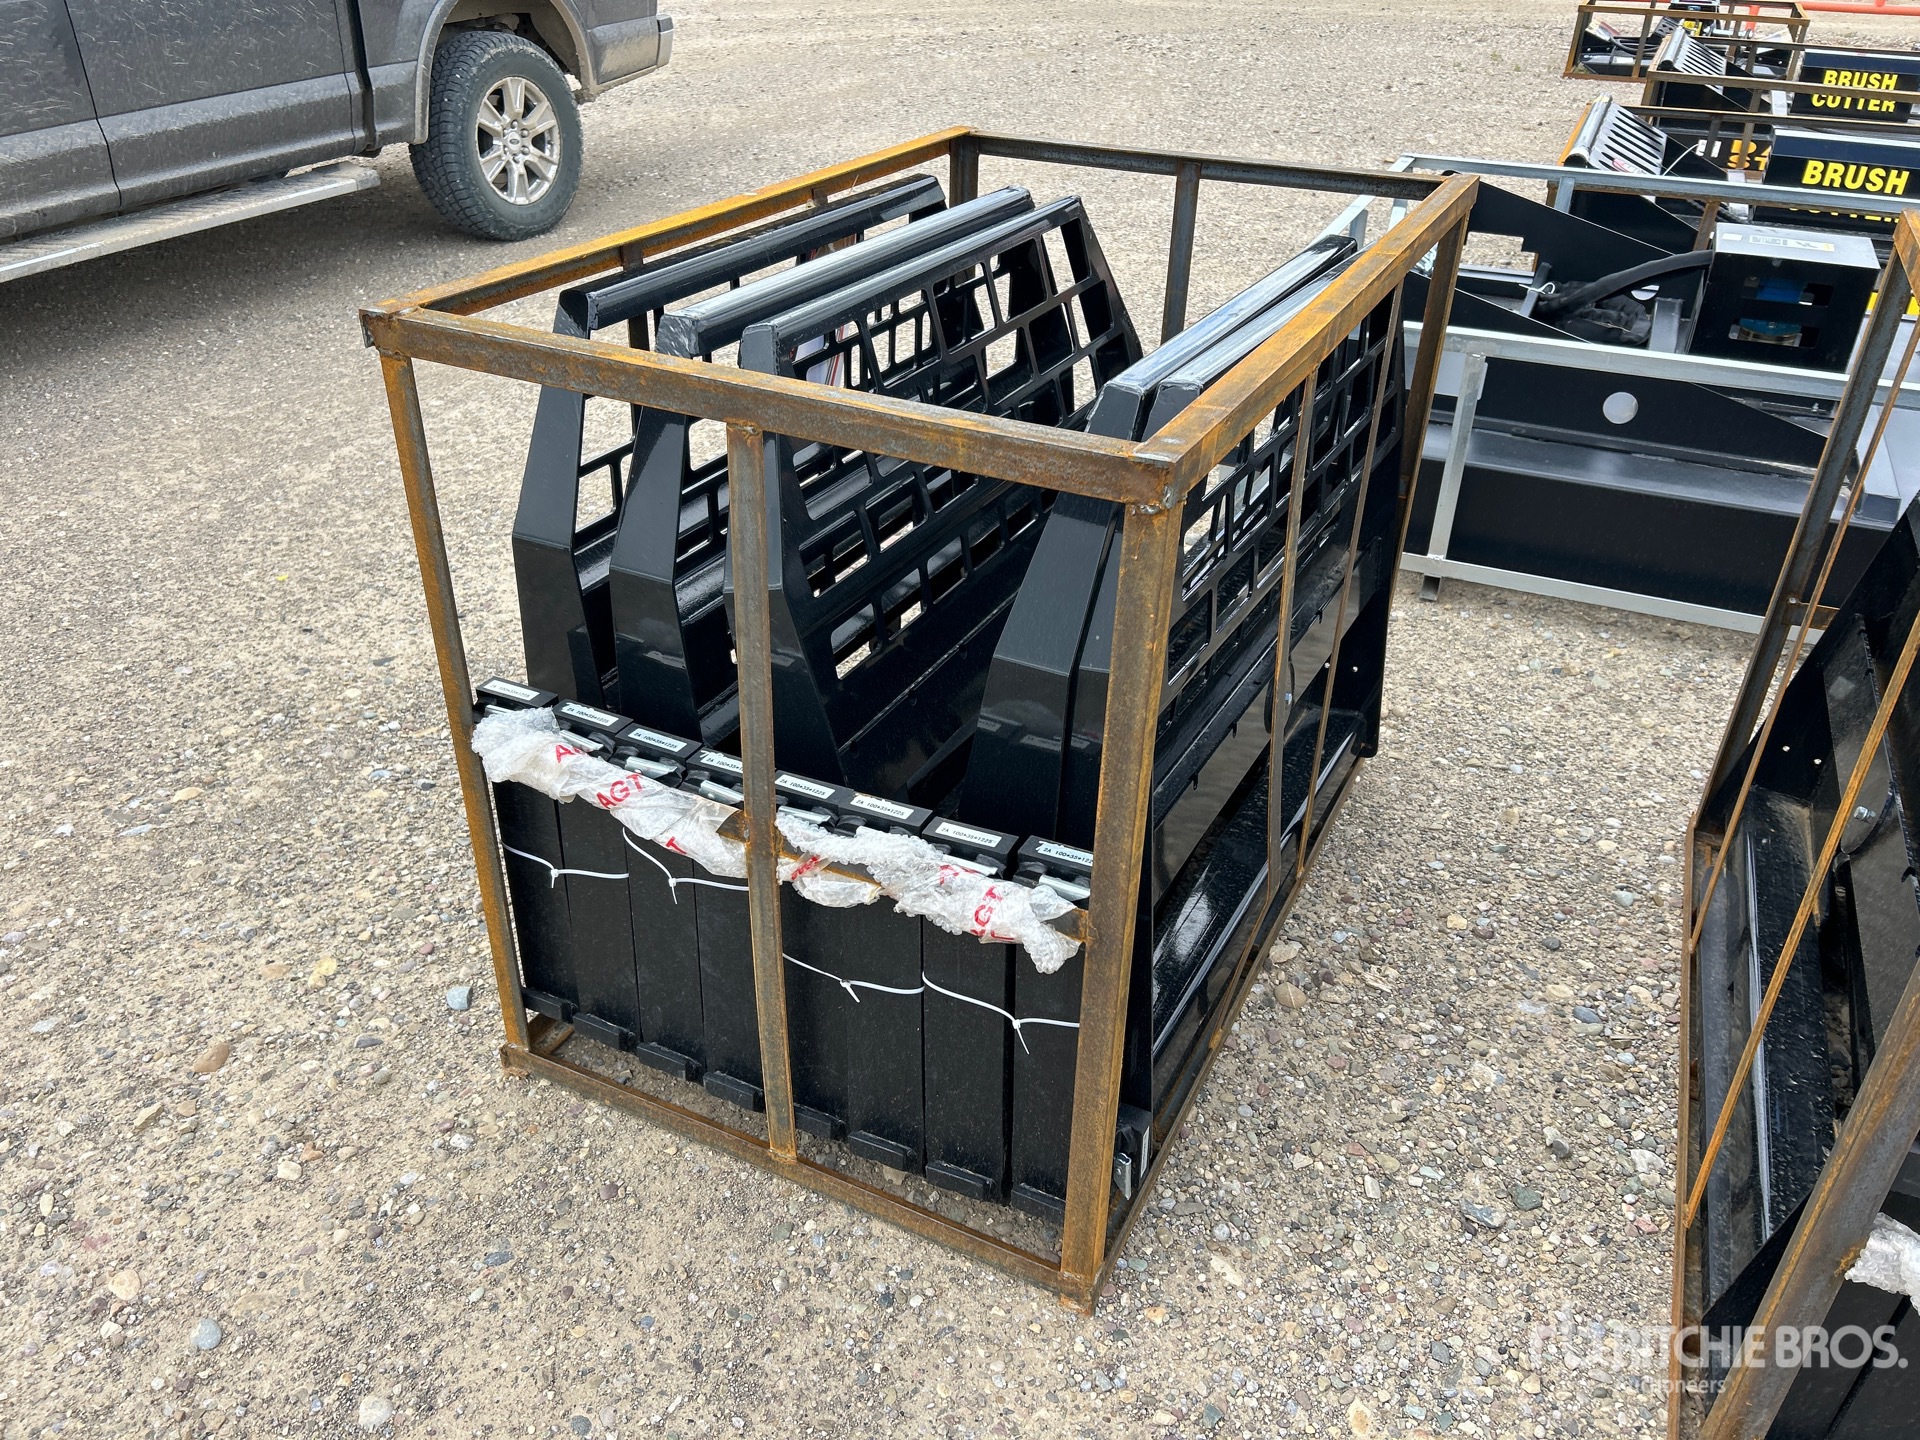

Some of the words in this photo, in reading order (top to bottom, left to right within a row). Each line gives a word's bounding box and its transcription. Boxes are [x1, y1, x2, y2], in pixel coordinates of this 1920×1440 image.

[1823, 69, 1899, 91] BRUSH
[1811, 93, 1896, 113] CUTTER
[1801, 159, 1910, 196] BRUSH
[596, 773, 643, 810] AGT
